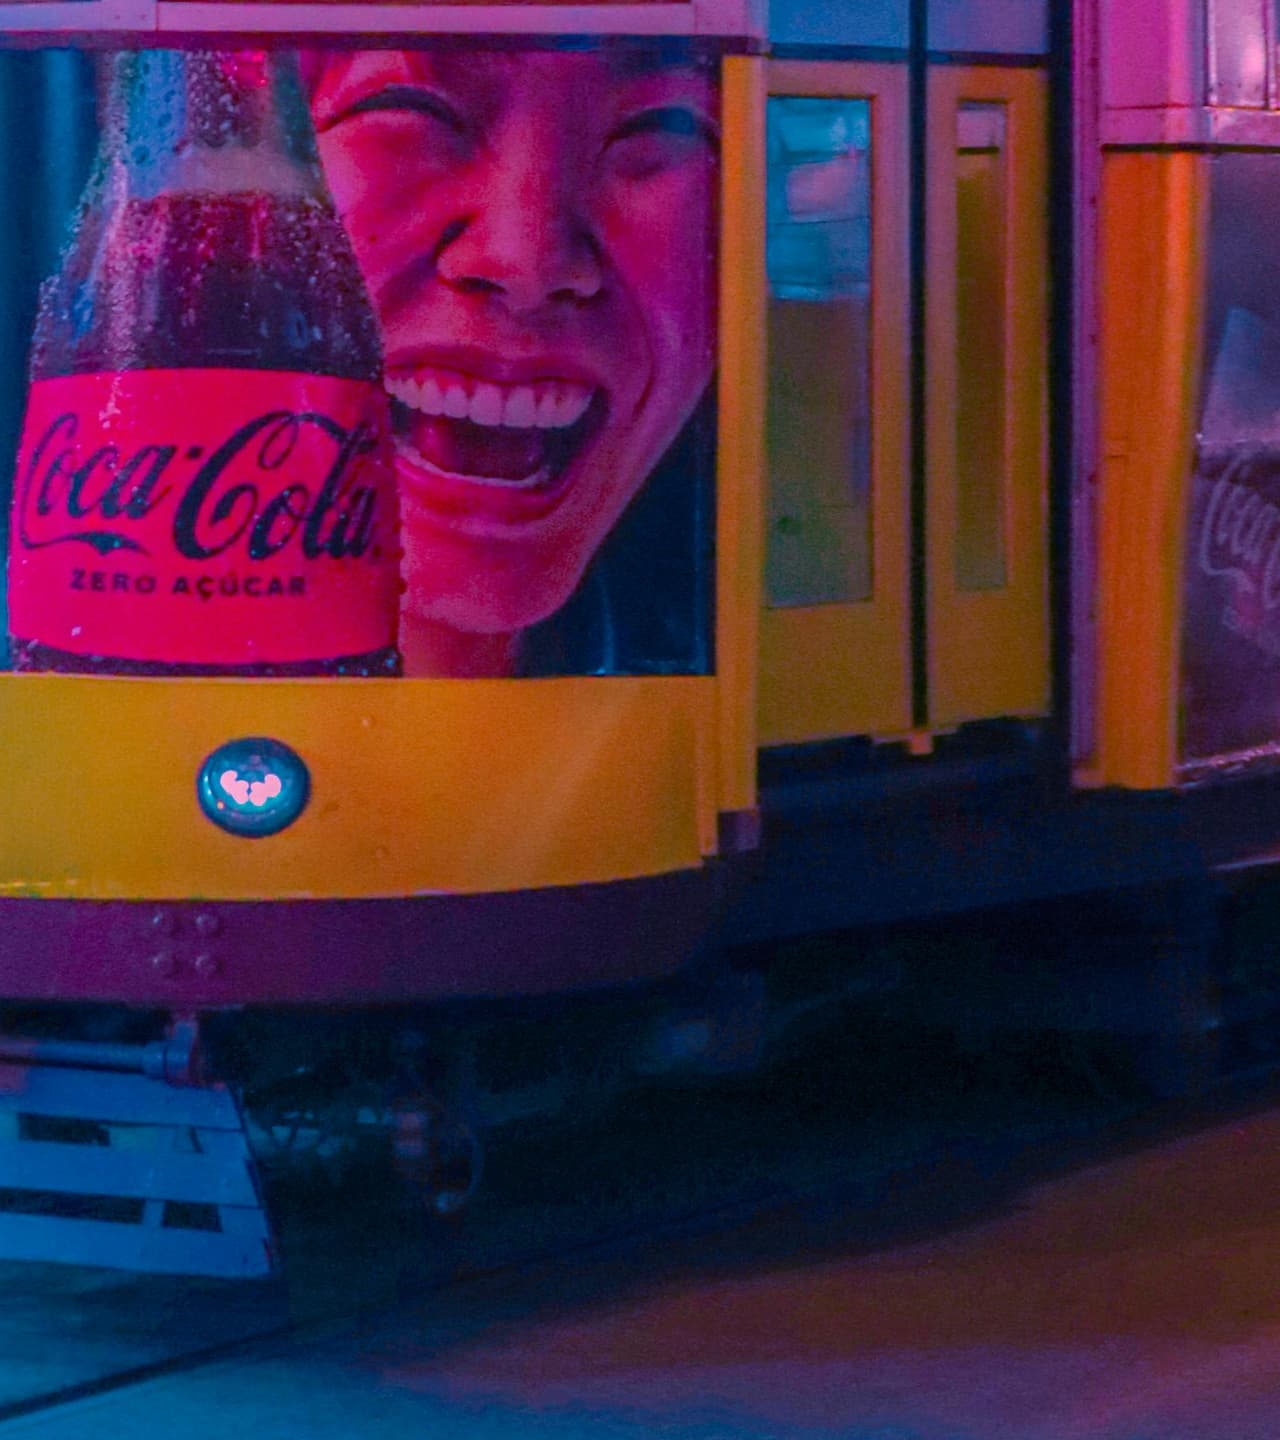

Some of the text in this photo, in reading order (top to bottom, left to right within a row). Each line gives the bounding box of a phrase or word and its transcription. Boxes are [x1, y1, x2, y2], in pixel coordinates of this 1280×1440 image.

[20, 409, 382, 562] Coca-Cola
[69, 569, 308, 603] ZERO AÇÚCAR
